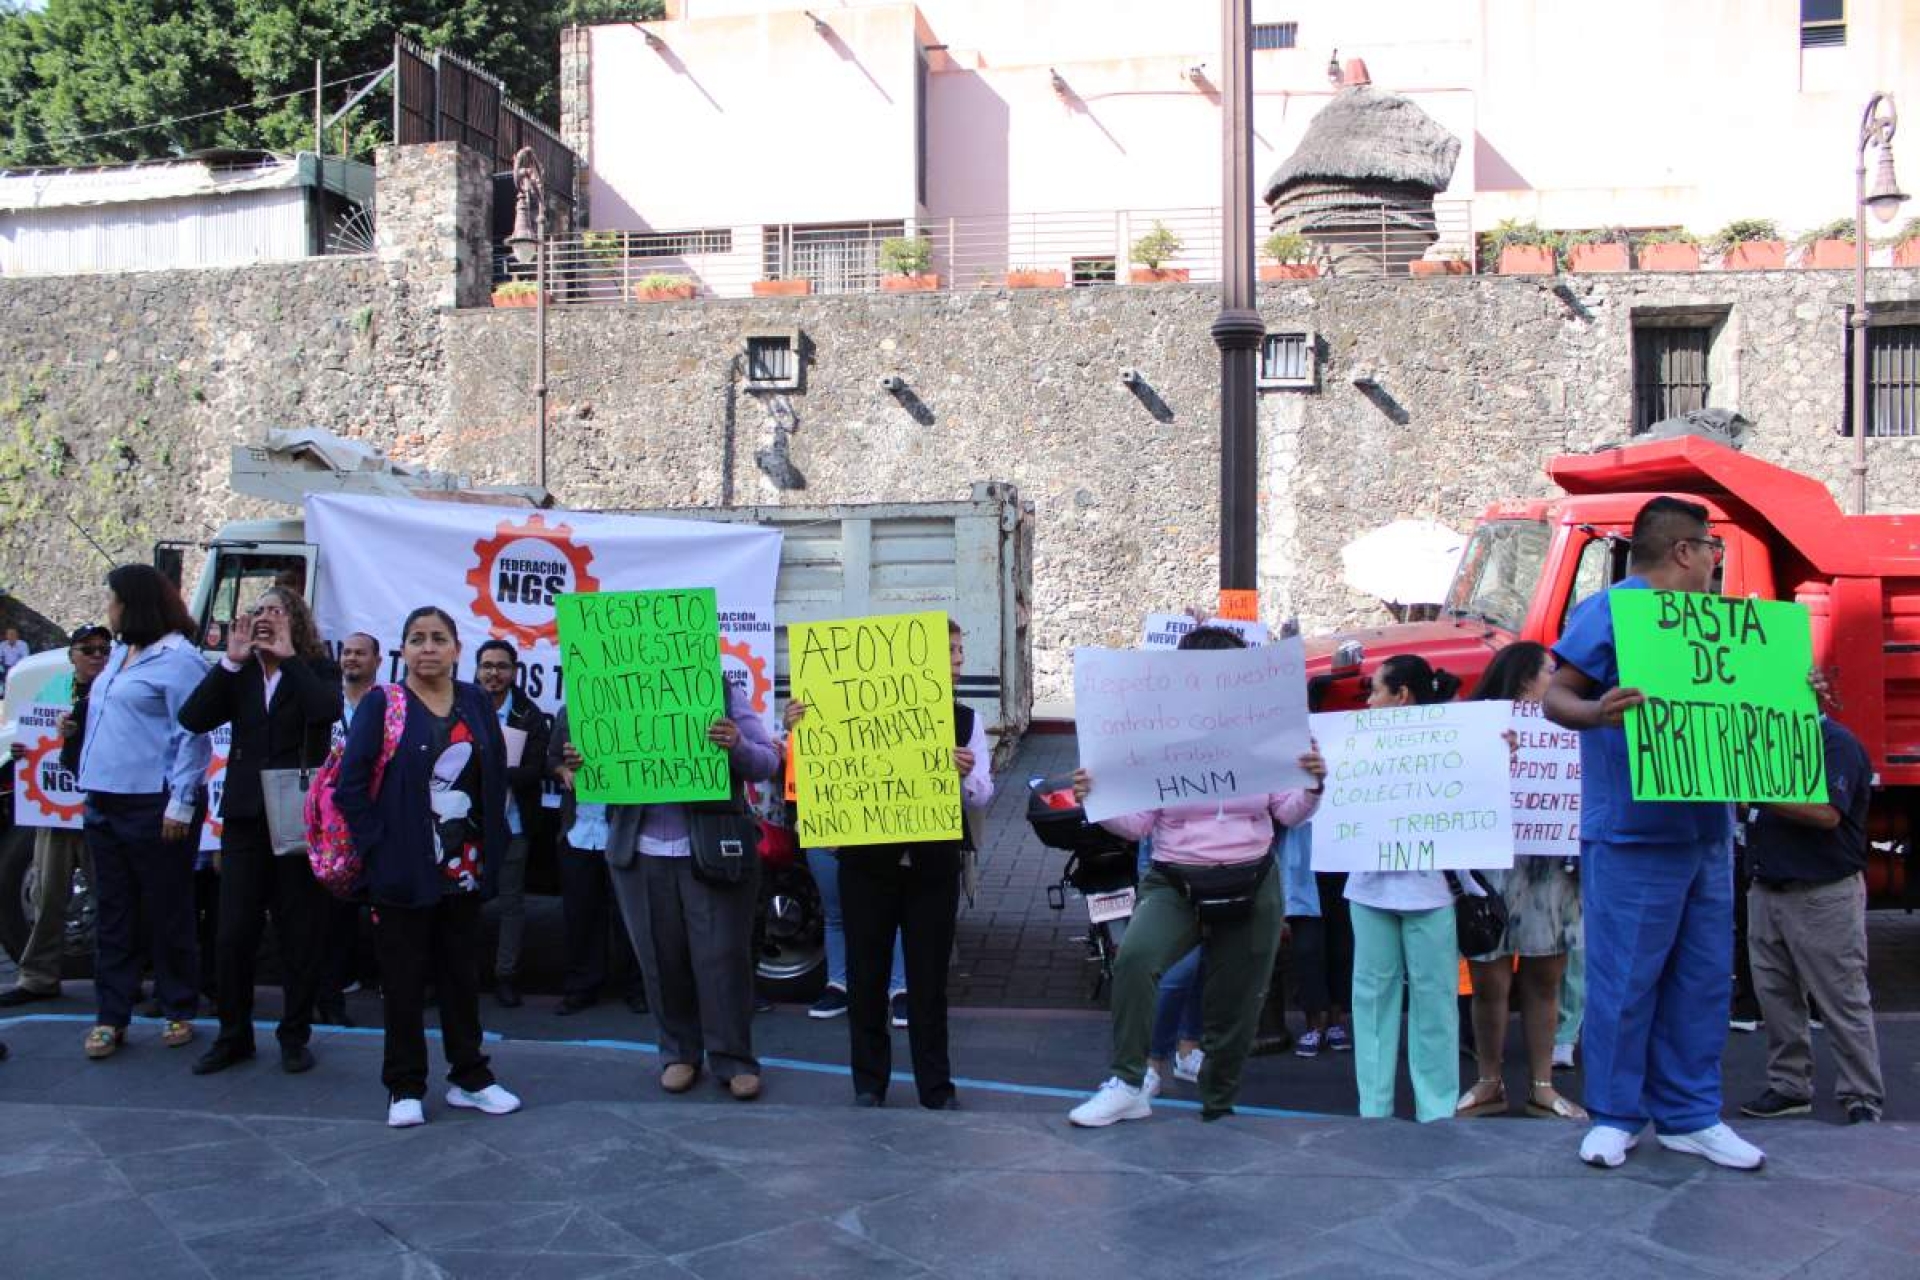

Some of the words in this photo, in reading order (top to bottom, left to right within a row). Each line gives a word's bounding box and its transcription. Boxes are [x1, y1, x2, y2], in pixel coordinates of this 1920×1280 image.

[500, 558, 567, 576] FEDERACIÓN
[497, 572, 565, 606] NGS
[576, 594, 706, 634] RESPETO
[1653, 591, 1767, 645] BASTA
[567, 643, 588, 672] A
[602, 631, 718, 670] NUESTRO
[799, 618, 929, 679] APOYO
[1688, 640, 1736, 684] DE
[577, 665, 716, 719] CONTRATO
[802, 688, 824, 720] A
[832, 668, 943, 713] TODOS
[1347, 705, 1445, 730] RESPETO
[798, 724, 838, 757] LOS
[1375, 730, 1458, 749] NUESTRO
[1637, 697, 1822, 798] ARBITRARIEDAD
[584, 765, 610, 791] DE
[617, 757, 728, 791] TRABAJO
[808, 754, 894, 781] DORES
[920, 746, 957, 775] DEL
[1335, 750, 1463, 782] CONTRATO
[1511, 761, 1557, 779] APOYO
[815, 778, 922, 804] HOSPITAL
[931, 777, 959, 797] DEL
[1156, 769, 1237, 802] HNM
[1333, 780, 1463, 807] COLECTIVO
[863, 805, 961, 834] MORELENSE
[1335, 822, 1364, 840] DE
[1389, 810, 1497, 834] TRABAJO
[1378, 839, 1435, 871] HNM
